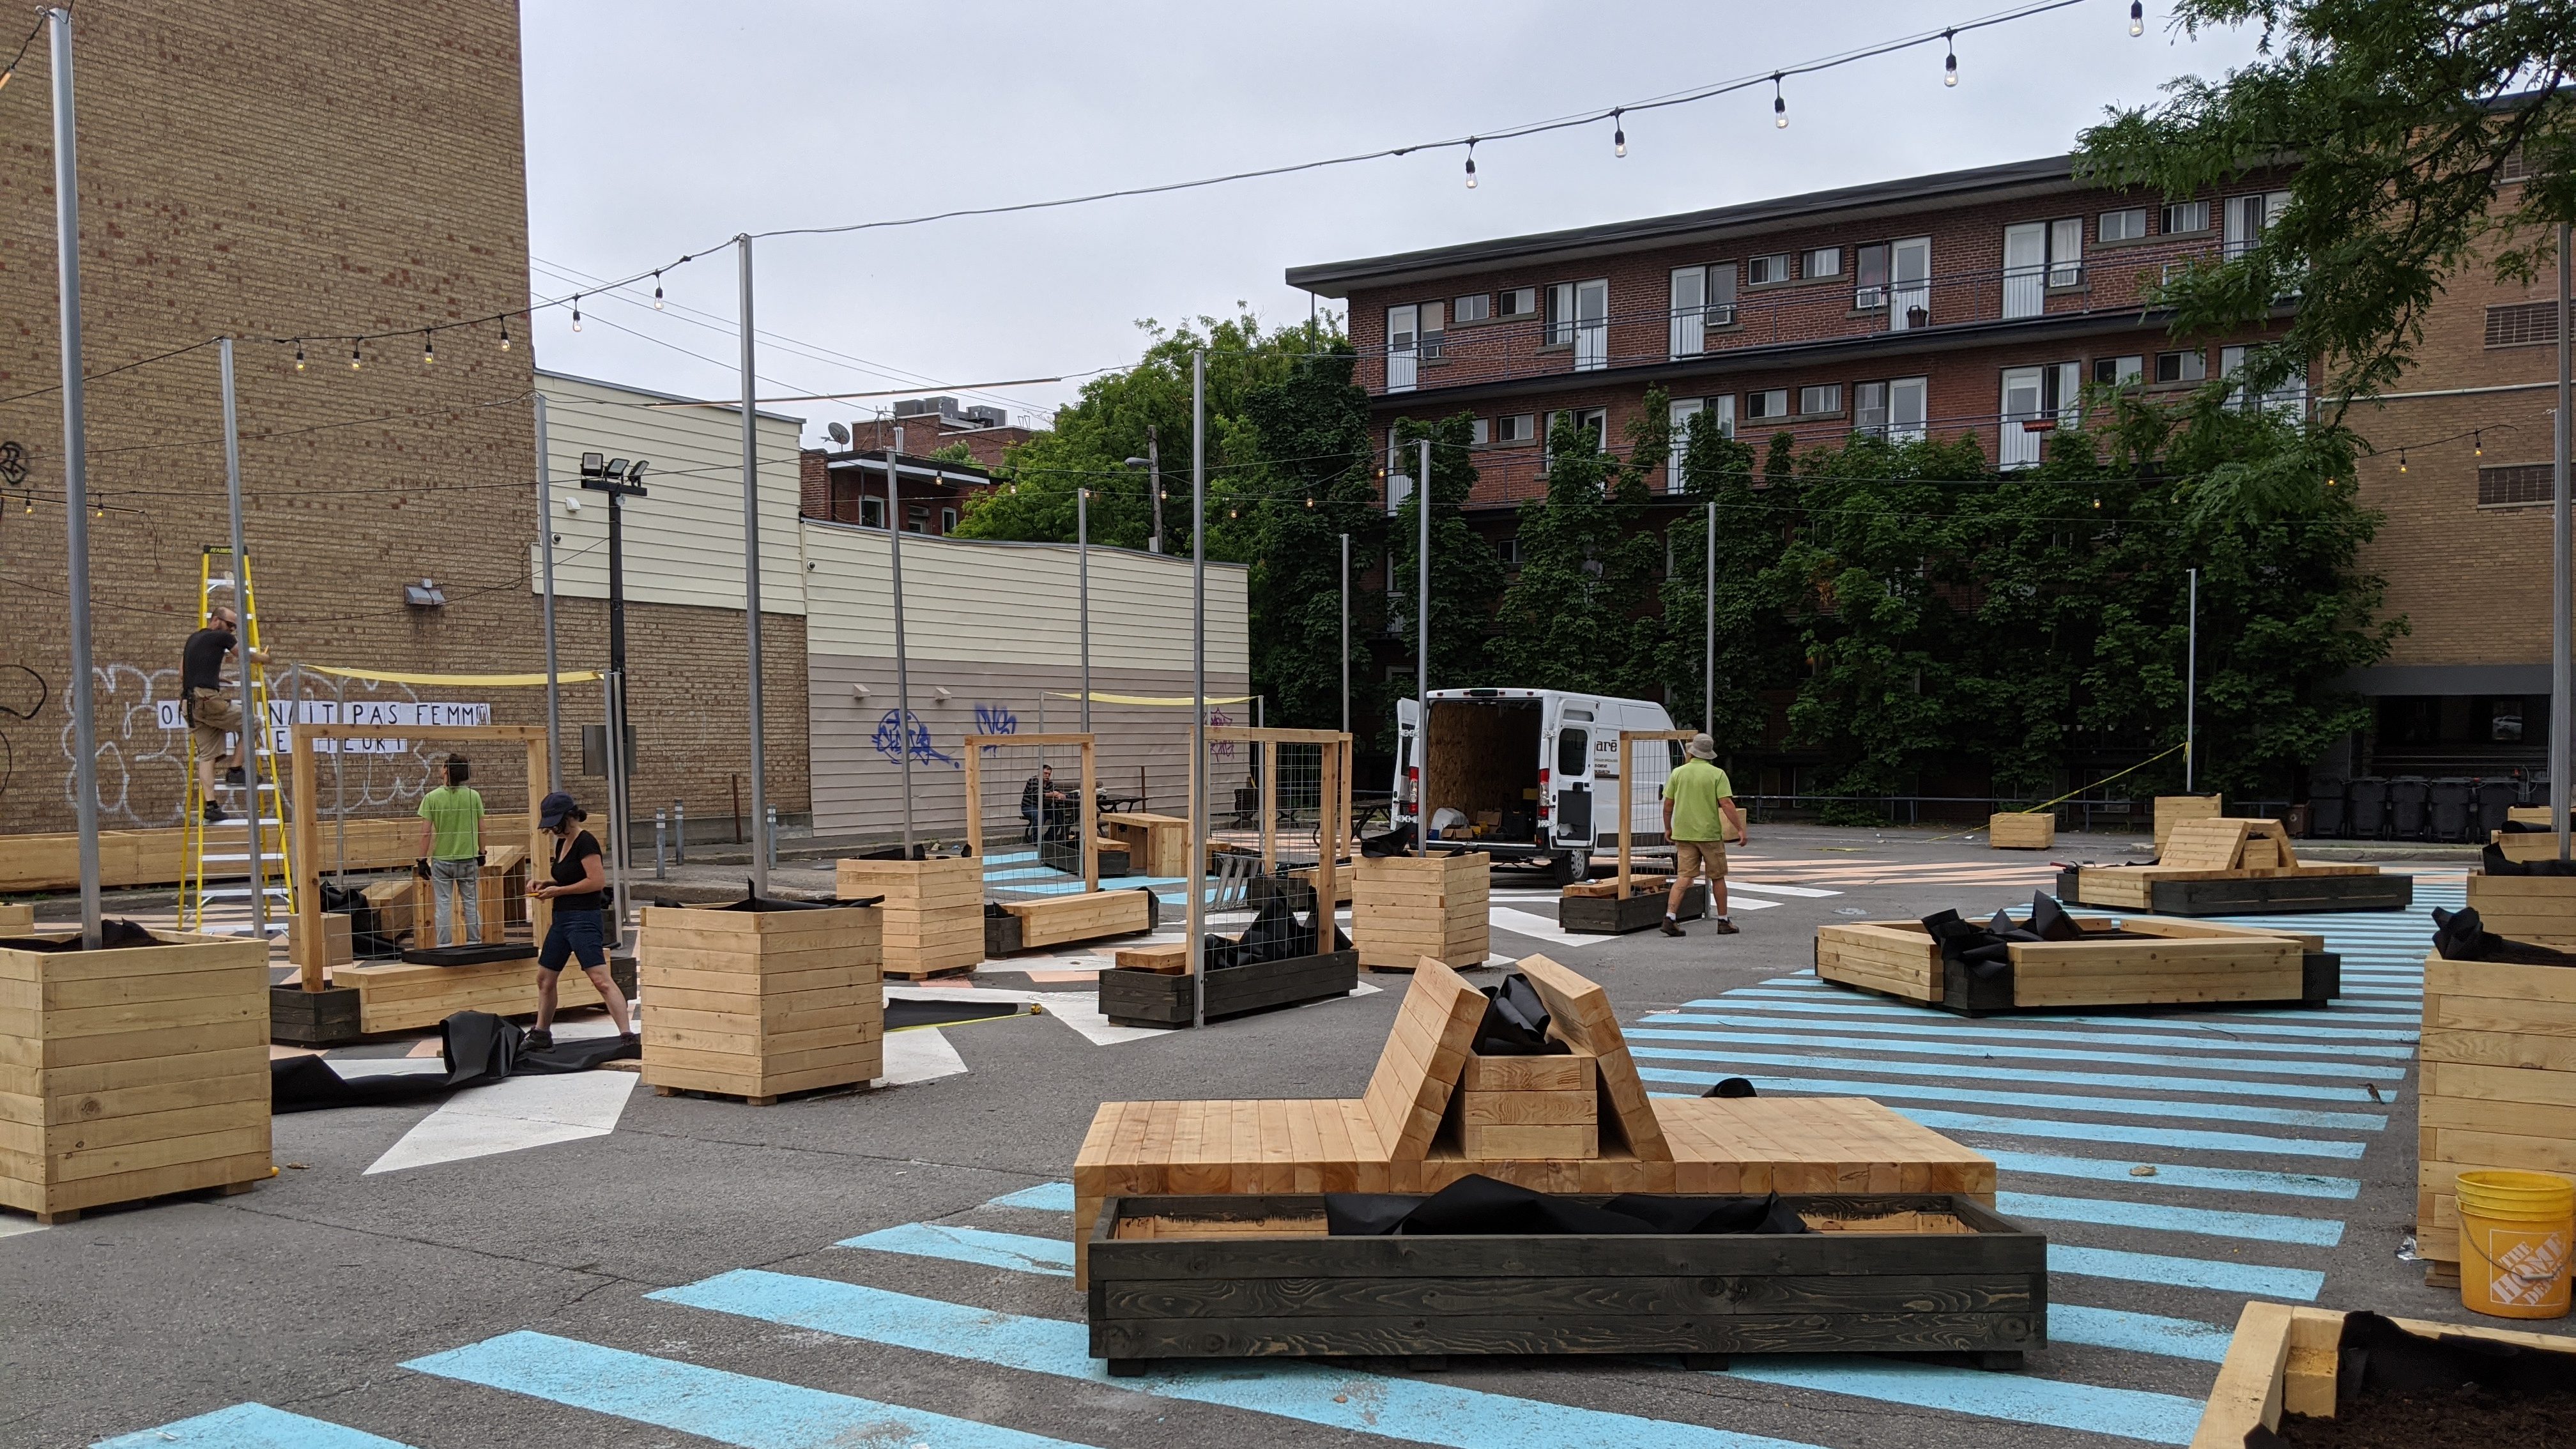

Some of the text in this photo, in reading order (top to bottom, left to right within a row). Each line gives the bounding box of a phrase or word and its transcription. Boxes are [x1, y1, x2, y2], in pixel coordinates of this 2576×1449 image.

[353, 705, 398, 724] PAS
[2492, 1233, 2563, 1305] HOME
[2498, 1241, 2534, 1270] THE
